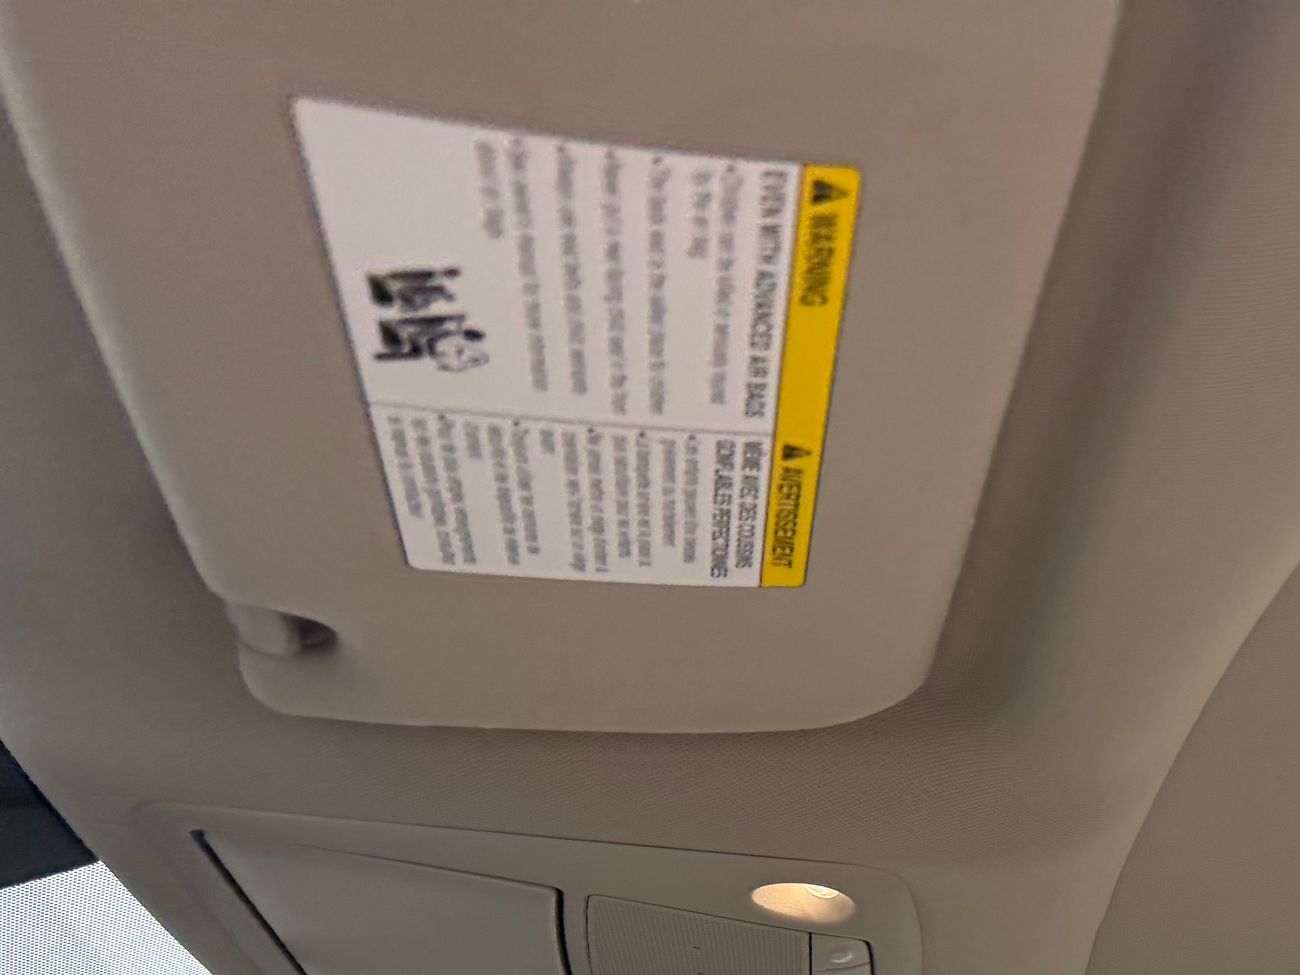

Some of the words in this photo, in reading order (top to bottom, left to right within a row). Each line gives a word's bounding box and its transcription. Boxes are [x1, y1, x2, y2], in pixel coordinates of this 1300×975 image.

[761, 170, 788, 218] EVEN
[757, 223, 784, 265] WITH
[800, 213, 839, 307] WARNING
[750, 269, 778, 350] ADVANCED
[749, 354, 770, 379] AIR
[745, 382, 767, 418] BAGS
[771, 466, 804, 567] AVERTISSEMENT
